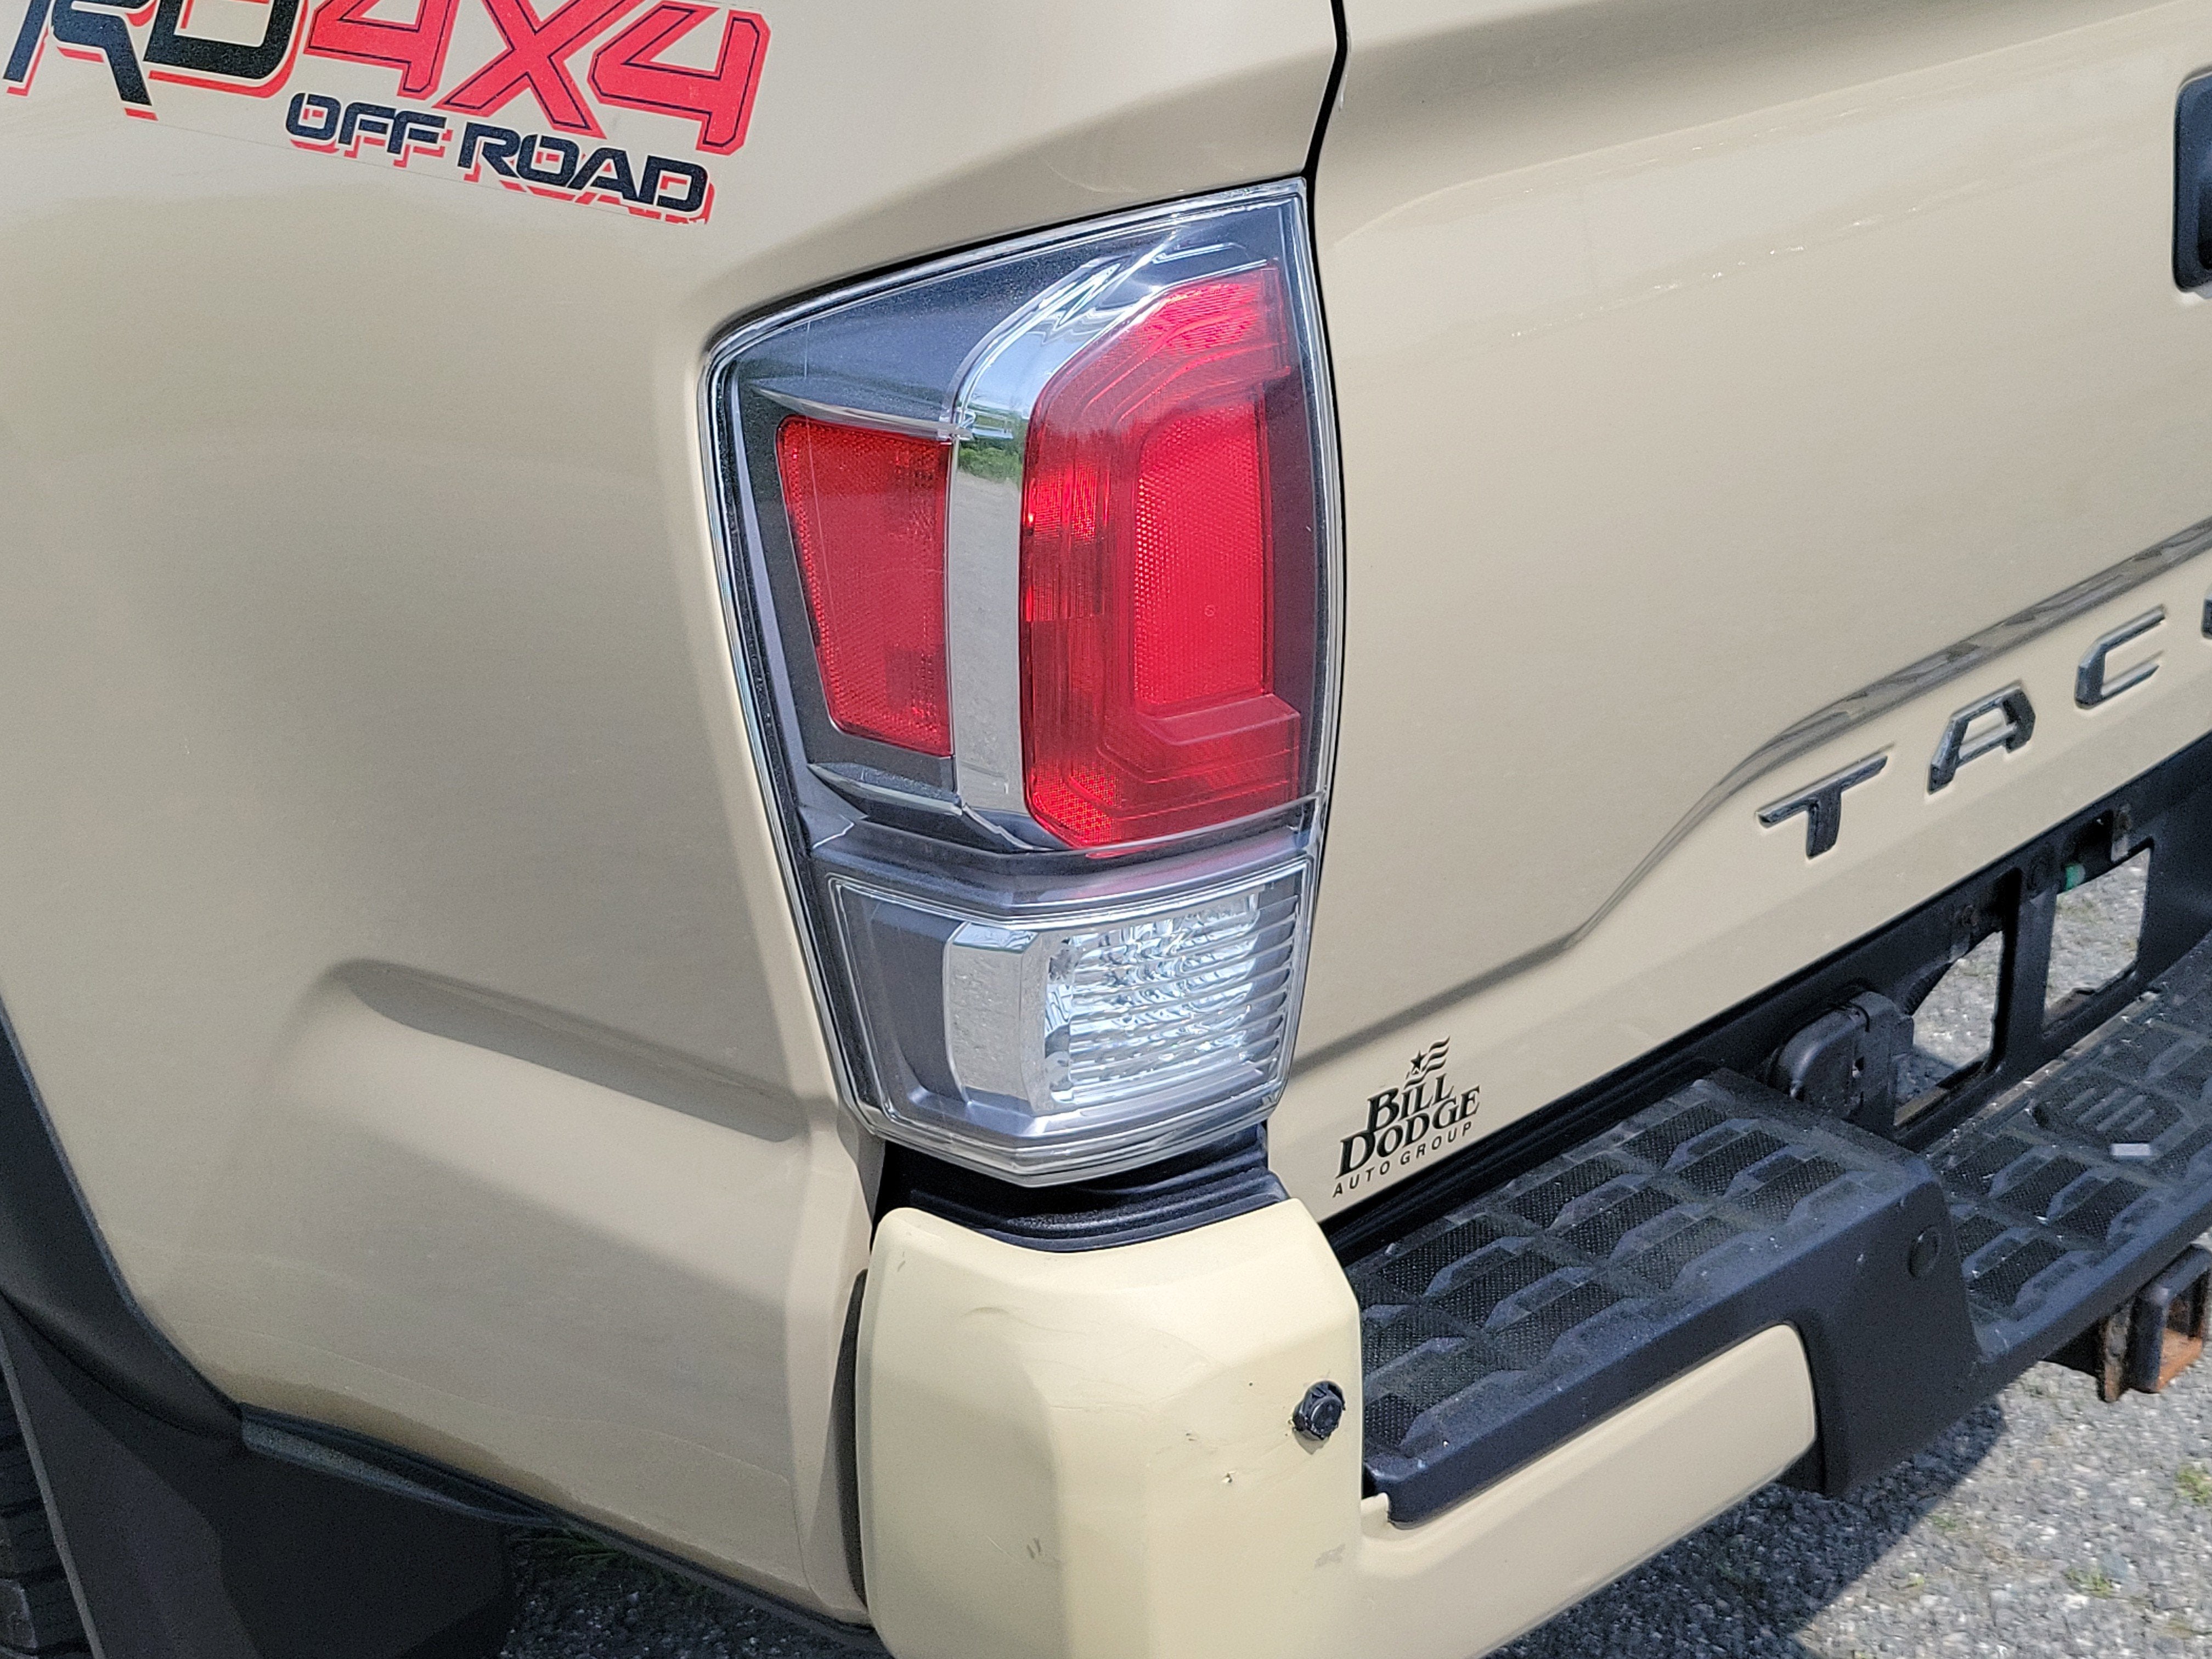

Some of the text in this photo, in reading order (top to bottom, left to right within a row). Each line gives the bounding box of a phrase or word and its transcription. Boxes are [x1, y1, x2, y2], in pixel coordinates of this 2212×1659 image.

[285, 92, 716, 225] OFF ROAD
[1755, 585, 2212, 859] TAC
[1335, 1085, 1481, 1179] DODGE
[1367, 1073, 1454, 1133] BILL
[1332, 1121, 1472, 1198] AUTO GROUP
